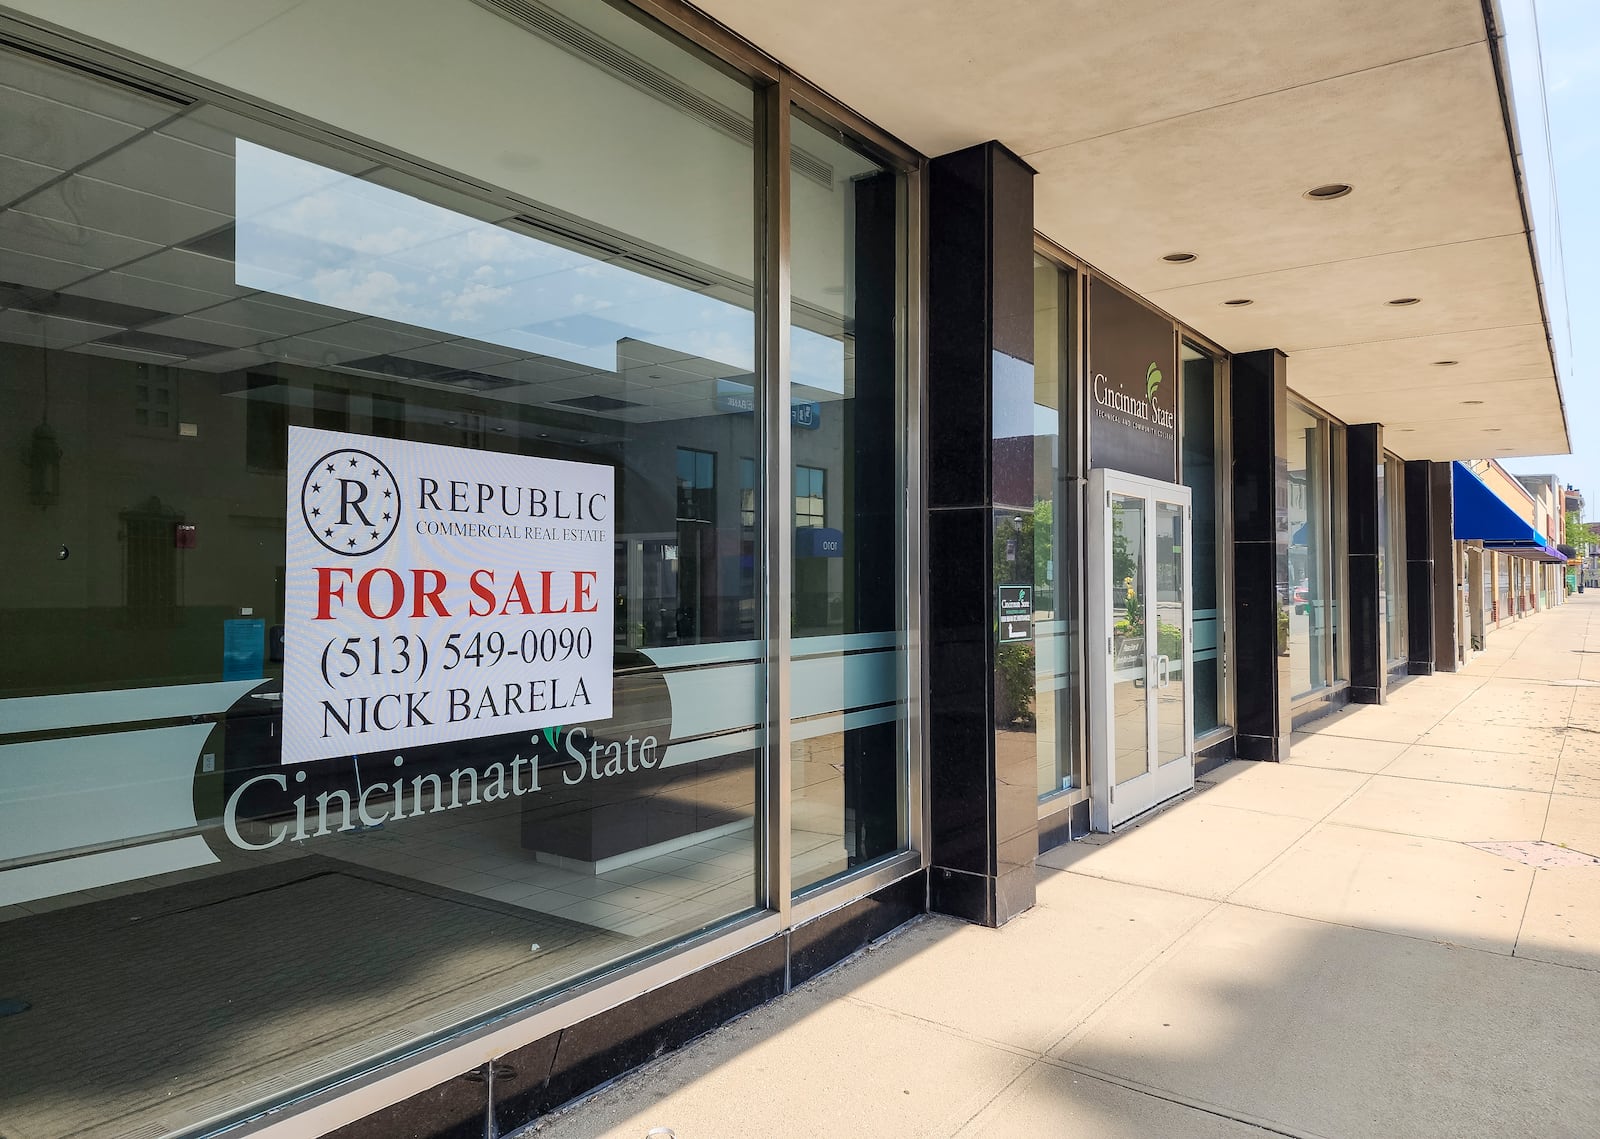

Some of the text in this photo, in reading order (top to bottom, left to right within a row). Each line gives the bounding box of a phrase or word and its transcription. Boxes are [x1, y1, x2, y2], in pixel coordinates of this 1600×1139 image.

[1094, 373, 1174, 429] Cincinnati State
[1122, 417, 1131, 427] AND
[335, 478, 375, 527] R
[418, 477, 608, 521] REPUBLIC
[416, 520, 607, 543] COMMERCIAL REAL ESTATE
[311, 567, 600, 620] FOR SALE
[320, 626, 592, 690] (513) 549-0090
[319, 676, 592, 739] NICK BARELA
[223, 726, 659, 852] Cincinnati State
